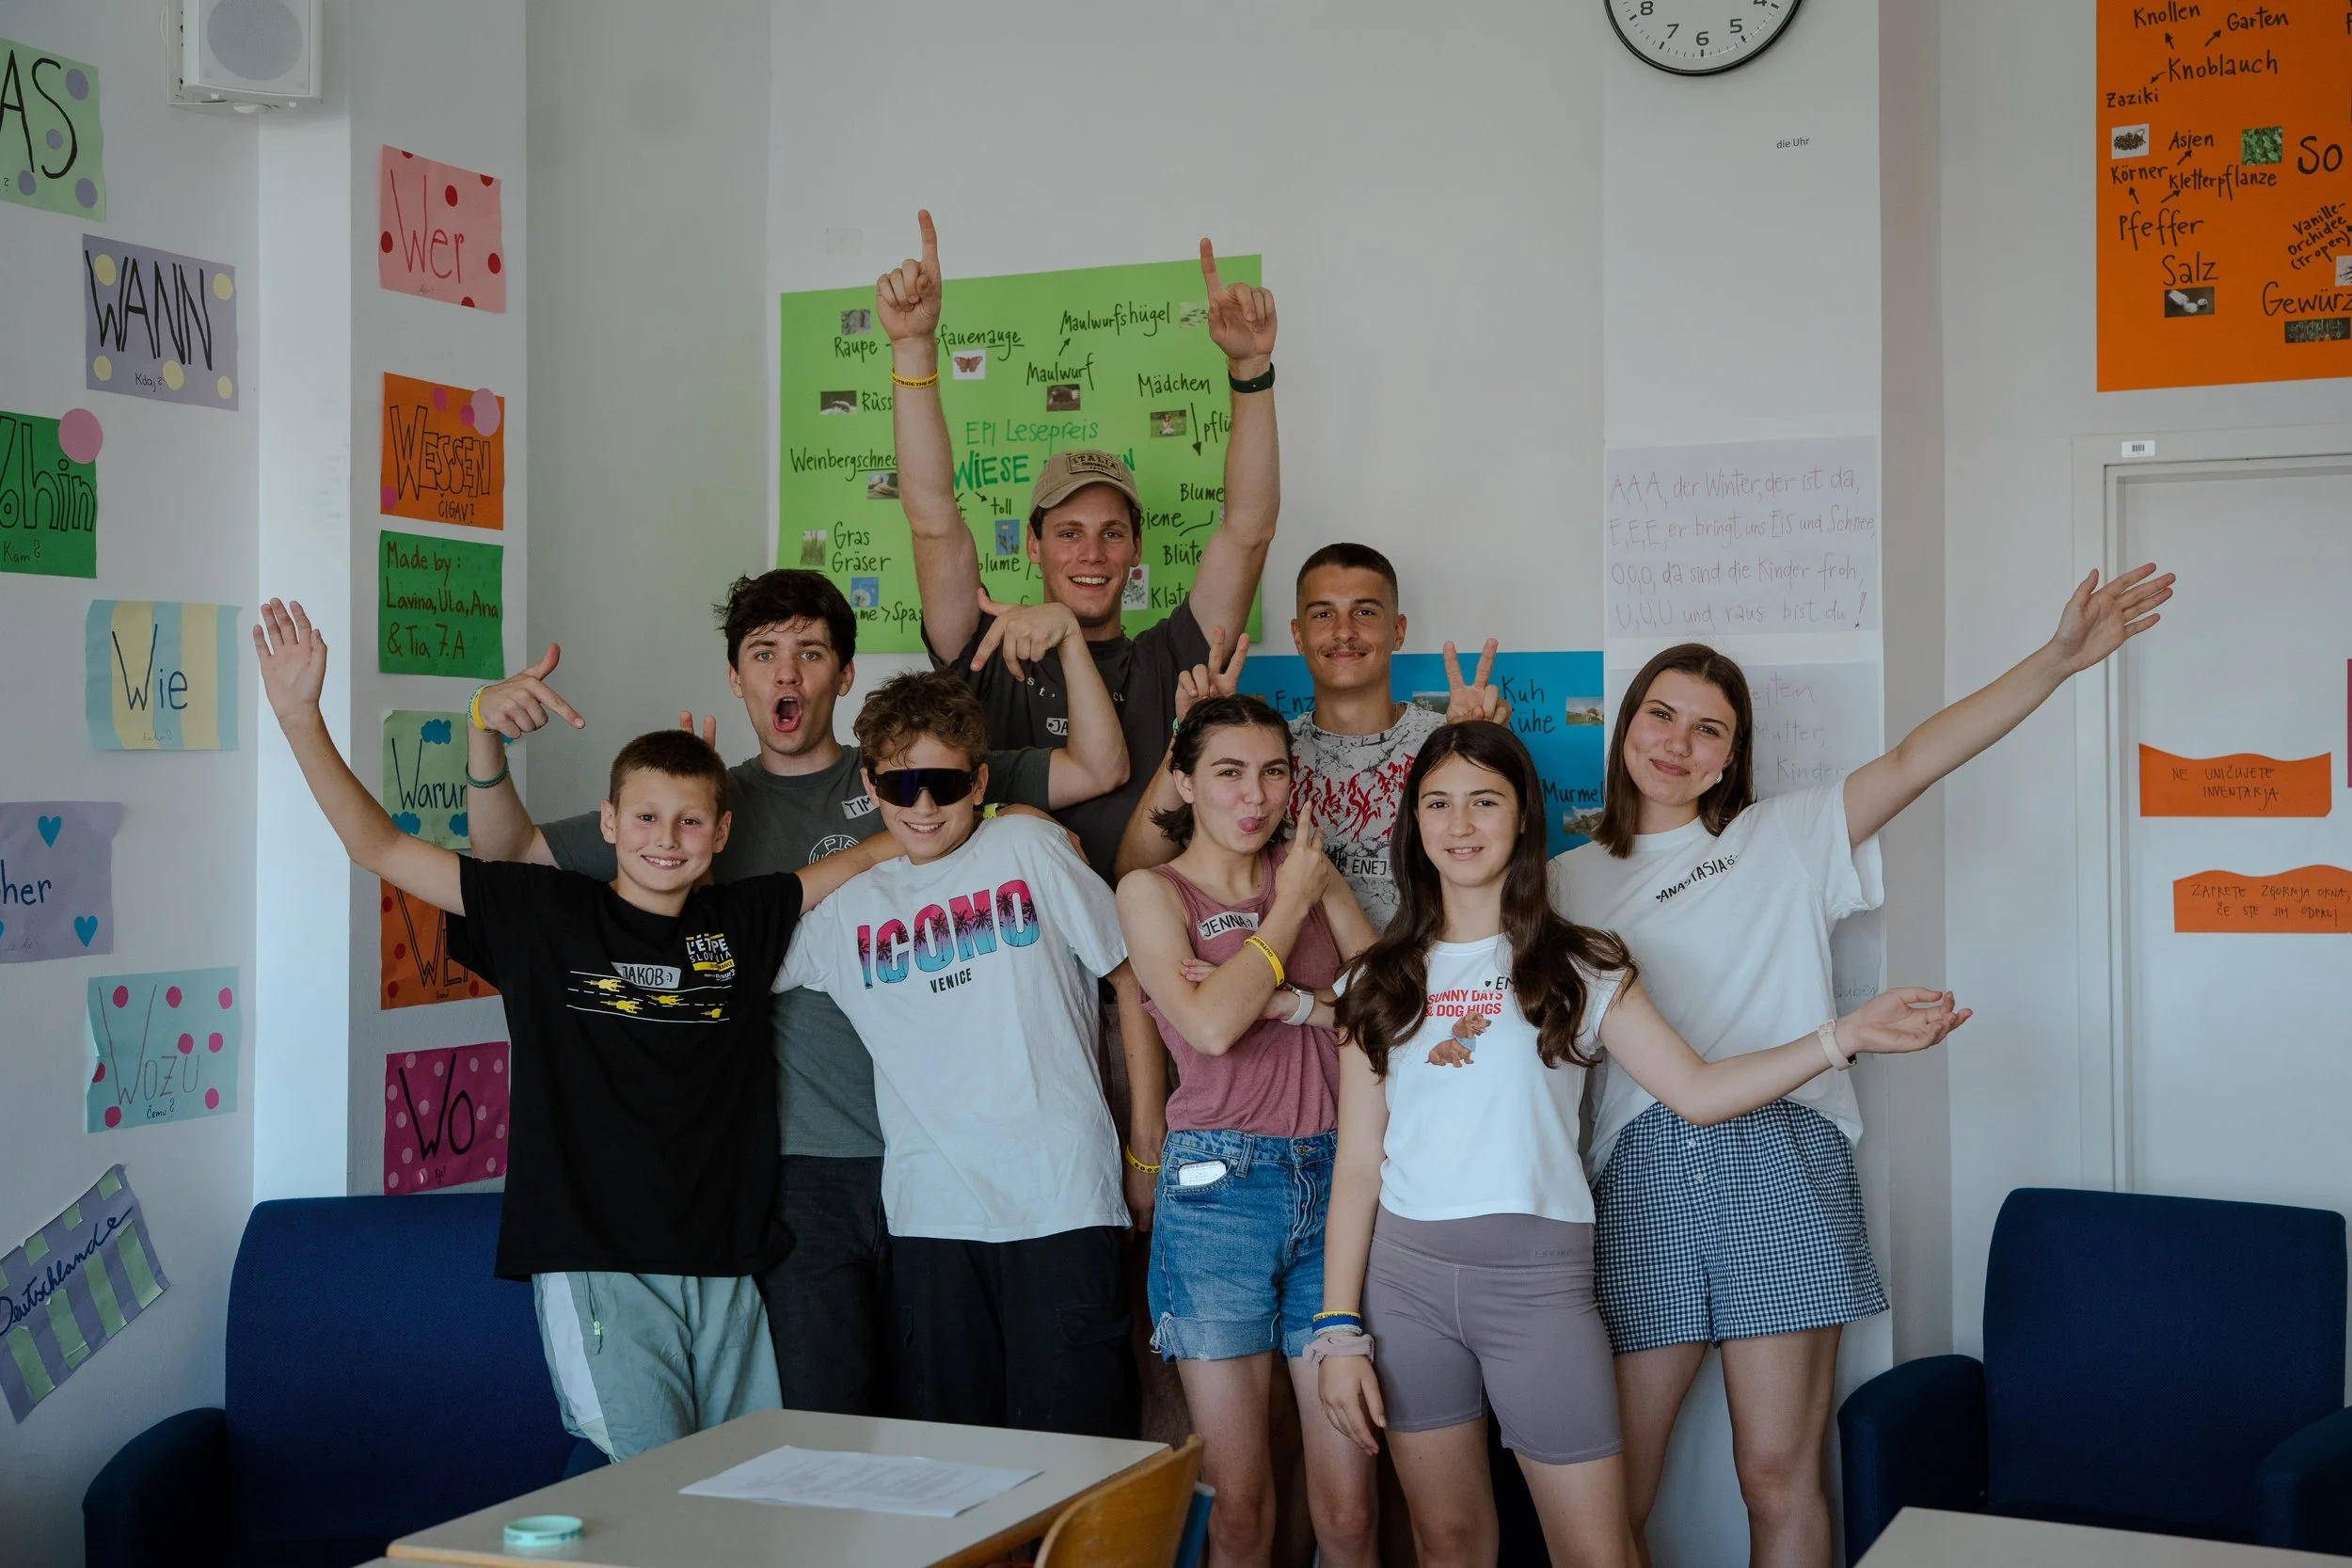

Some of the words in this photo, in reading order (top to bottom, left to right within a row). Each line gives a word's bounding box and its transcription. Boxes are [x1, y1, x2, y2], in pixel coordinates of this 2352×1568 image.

[1729, 19, 1743, 33] 5
[2133, 1, 2201, 28] Knollen
[2227, 7, 2289, 31] Garten
[1666, 24, 1679, 39] 7
[1695, 31, 1709, 46] 6
[2168, 49, 2278, 83] Knoblauch
[2106, 87, 2159, 108] Zaziki
[1776, 139, 1790, 149] die
[1792, 137, 1810, 148] Uhr
[2168, 130, 2214, 150] Asien
[2110, 164, 2168, 184] Körner
[2169, 164, 2277, 200] Kletterpflanze
[390, 168, 464, 283] Wer
[2119, 208, 2203, 250] Pfeffer
[2161, 251, 2218, 286] Salz
[85, 250, 213, 371] WANN
[1059, 301, 1171, 336] Maulwurfshügel
[834, 335, 878, 363] Raupe
[1026, 353, 1094, 391] Maulwurf
[1137, 373, 1211, 398] Mädchen
[1007, 418, 1099, 454] Lesepreis
[389, 404, 490, 501] WESSEN
[1073, 455, 1117, 470] ITALIA
[1180, 483, 1224, 502] Blume
[1673, 475, 1701, 499] der
[1764, 472, 1797, 499] der
[1802, 467, 1823, 492] ist
[991, 497, 1011, 515] toll
[834, 521, 869, 549] Gras
[1668, 522, 1687, 538] er
[1694, 513, 1741, 548] bringt
[1745, 520, 1767, 536] uns
[1799, 513, 1822, 531] und
[387, 541, 428, 570] Made
[832, 551, 892, 573] Gräser
[1162, 540, 1202, 565] Blüte
[1662, 562, 1683, 585] da
[1690, 561, 1720, 584] sind
[1727, 562, 1752, 580] die
[1757, 556, 1810, 588] Kinder
[470, 590, 499, 619] Ana
[1683, 603, 1715, 630] und
[1726, 604, 1765, 624] raus
[1782, 598, 1820, 623] bist
[387, 622, 403, 657] &
[405, 625, 431, 658] Tia
[111, 623, 187, 711] Wie
[1275, 689, 1314, 715] Enz
[1502, 676, 1545, 704] Kuh
[1776, 755, 1846, 784] Kinder
[2171, 767, 2188, 781] NE
[0, 859, 52, 906] her
[1660, 859, 1727, 902] ANASTASIA
[394, 886, 469, 988] WE
[857, 879, 1041, 990] ICONO
[1201, 914, 1247, 938] JENNA
[622, 965, 664, 987] JAKOB
[930, 968, 972, 994] VENICE
[1427, 990, 1470, 1005] SUNNY
[1437, 1005, 1464, 1018] DOG
[1467, 1003, 1502, 1015] HUGS
[399, 1053, 476, 1162] Wo
